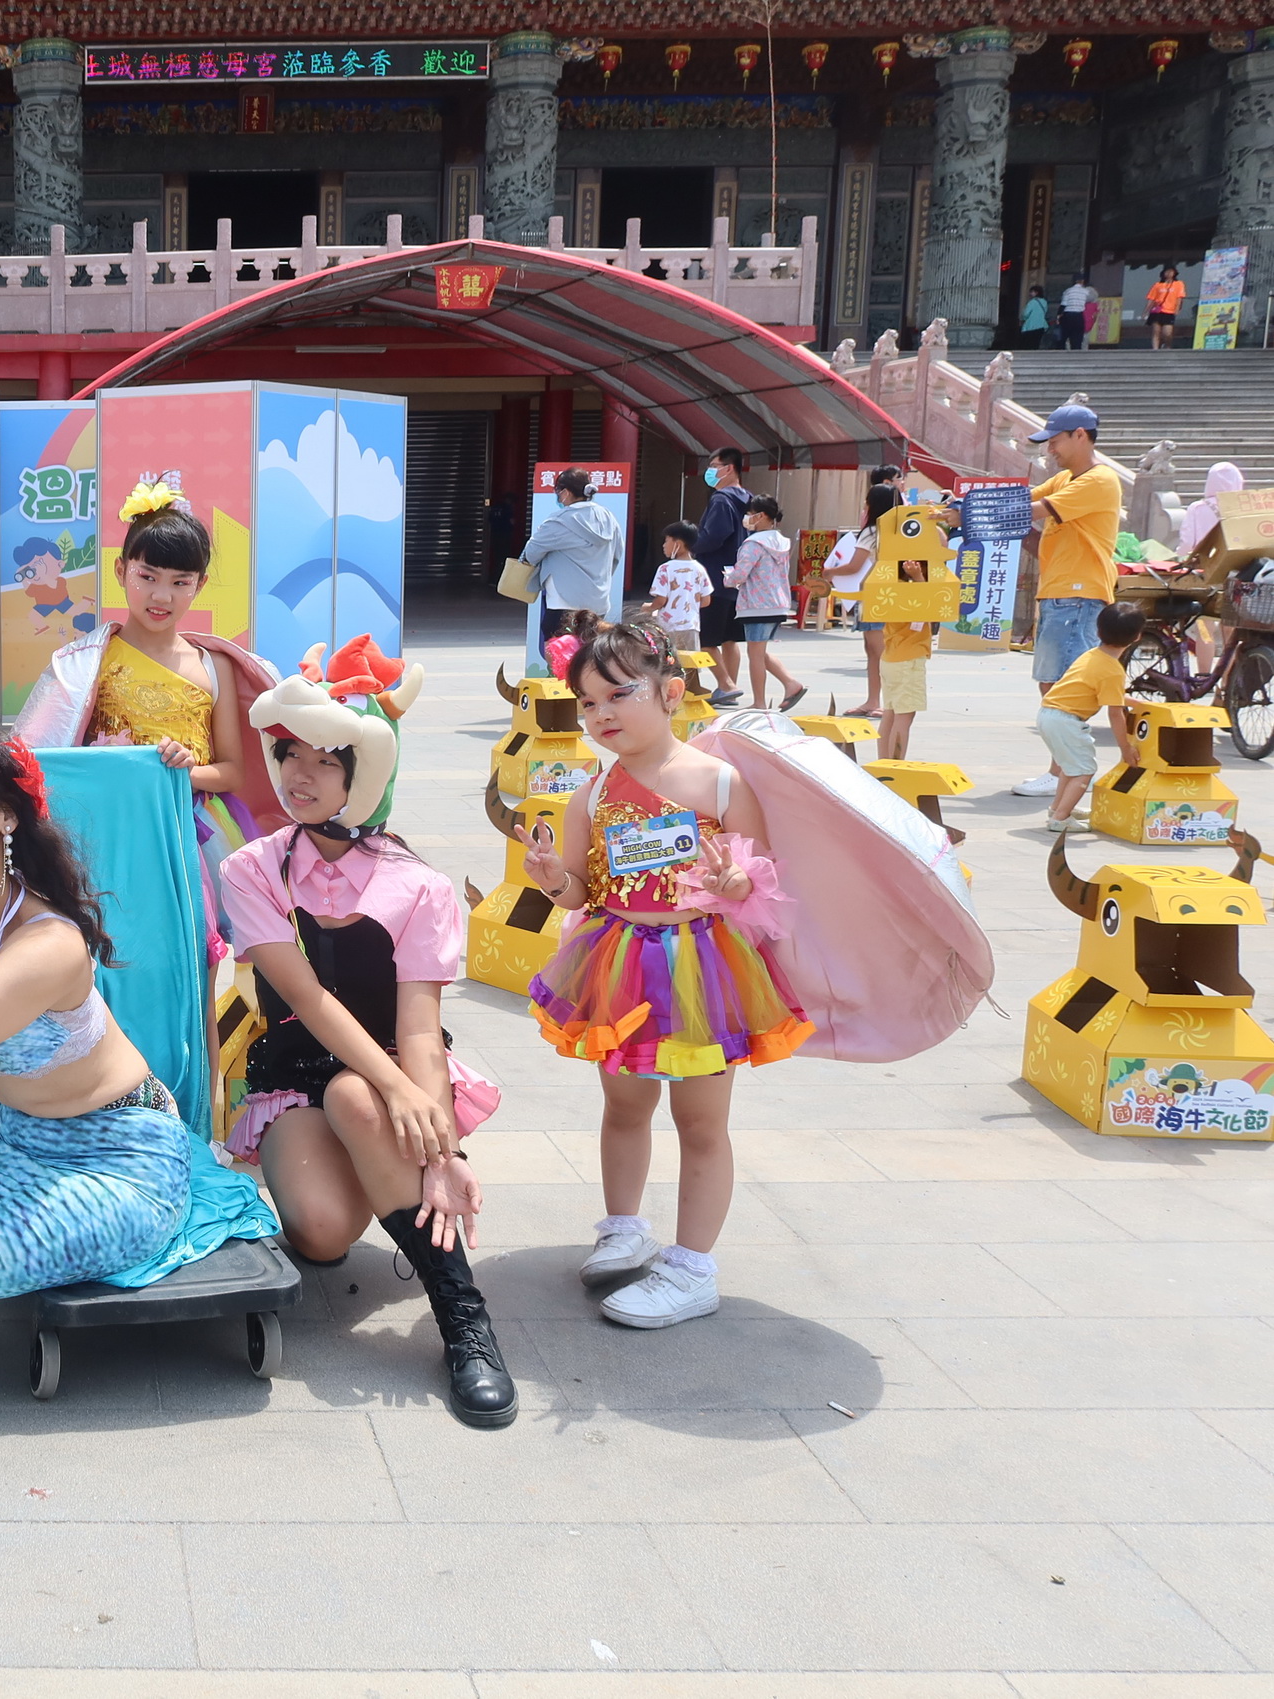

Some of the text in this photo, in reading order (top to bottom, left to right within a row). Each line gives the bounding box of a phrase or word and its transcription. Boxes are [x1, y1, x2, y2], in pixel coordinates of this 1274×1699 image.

[420, 49, 476, 75] 歡迎
[541, 470, 622, 487] 賓章點
[960, 549, 981, 605] 蓋章處
[622, 839, 662, 854] HIGH COW
[677, 838, 692, 850] 11
[1111, 1102, 1269, 1132] 國際海牛文化節
